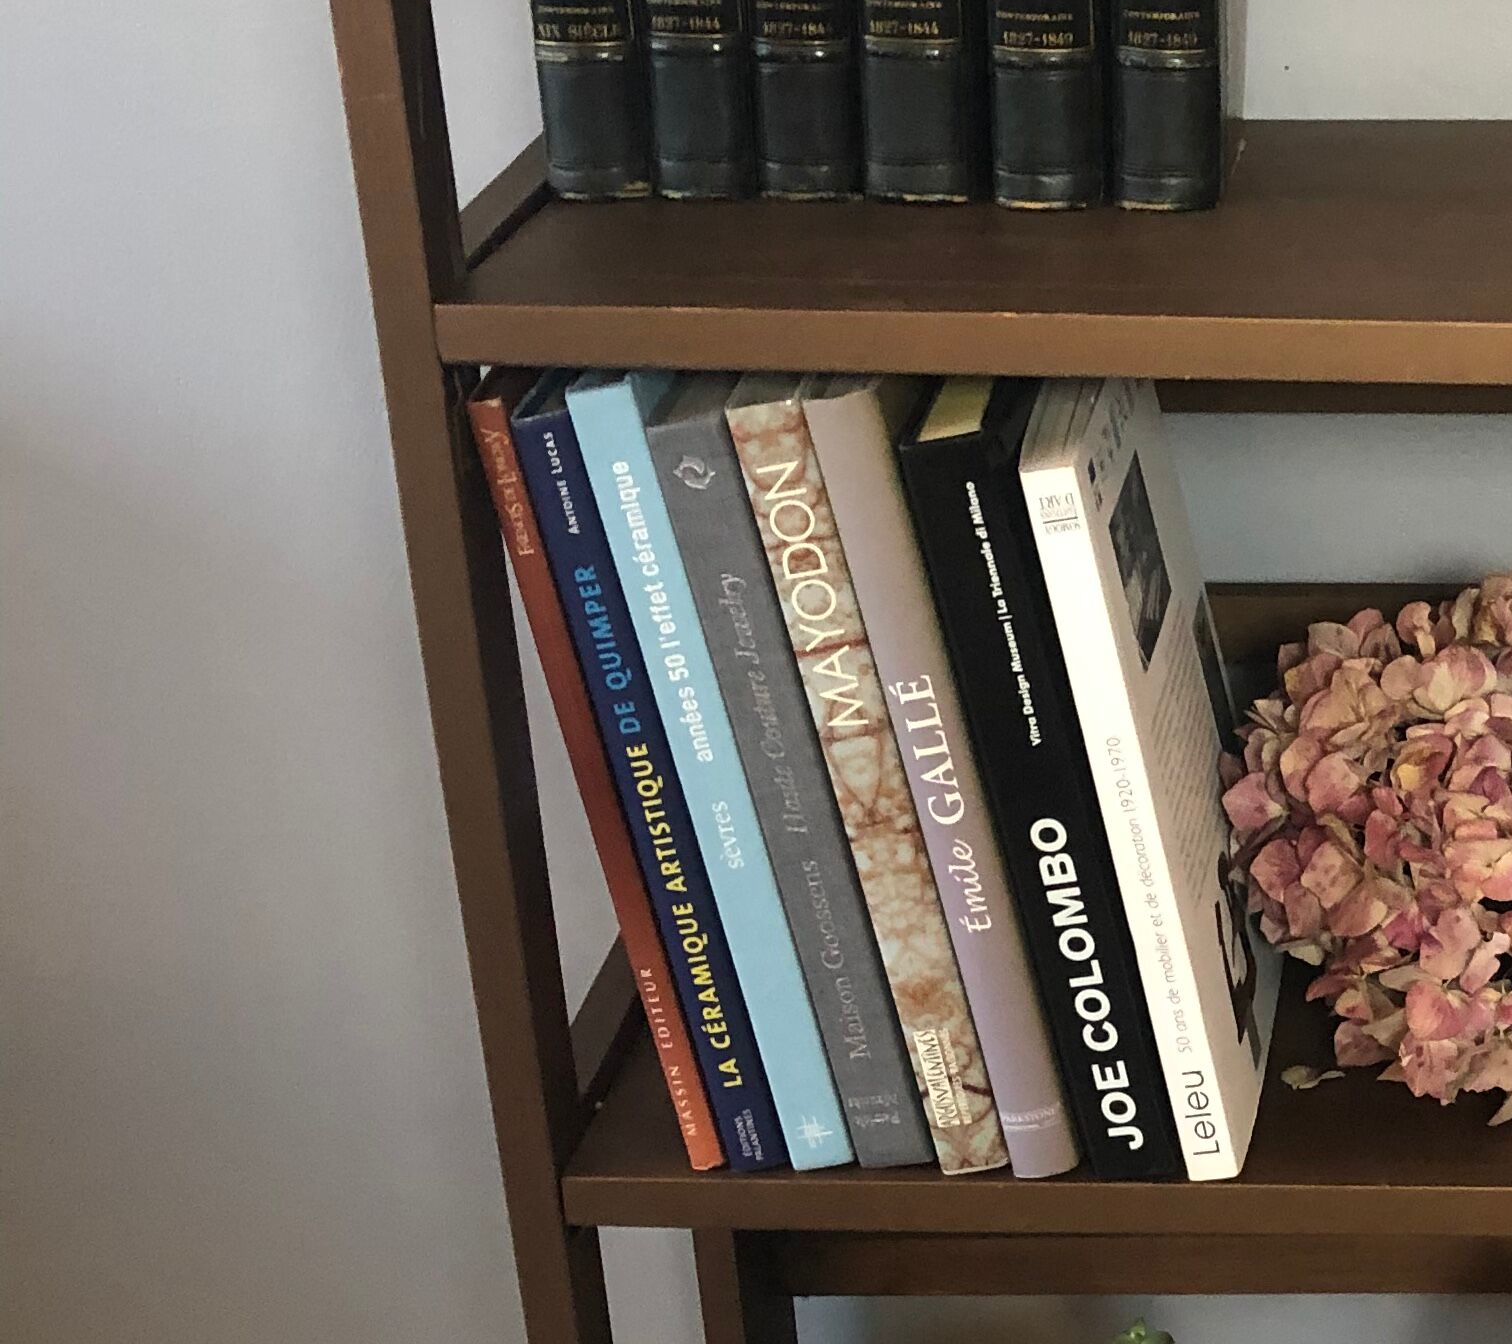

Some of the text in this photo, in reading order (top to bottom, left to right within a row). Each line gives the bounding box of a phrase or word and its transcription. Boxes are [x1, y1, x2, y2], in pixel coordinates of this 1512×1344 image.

[543, 431, 580, 535] ANTOINE LUCAS
[612, 460, 713, 763] années 50 l'effet céramique
[755, 460, 869, 727] MAYODON
[965, 481, 1042, 746] Vitra Design Museum La Triennale di Milano
[574, 564, 743, 1088] LA CÉRAMIQUE ARTISTIQUE DE QUIMPER
[712, 800, 744, 869] sèvres
[888, 674, 992, 934] Émile GALLÉ
[1106, 736, 1193, 1053] 50 ans de mobilier et de décoration 1920-1970
[801, 859, 871, 1060] Maison Goossens
[1030, 817, 1144, 1151] JOE COLOMBO
[668, 1065, 698, 1137] MASSIN
[1181, 1069, 1221, 1157] Leleu
